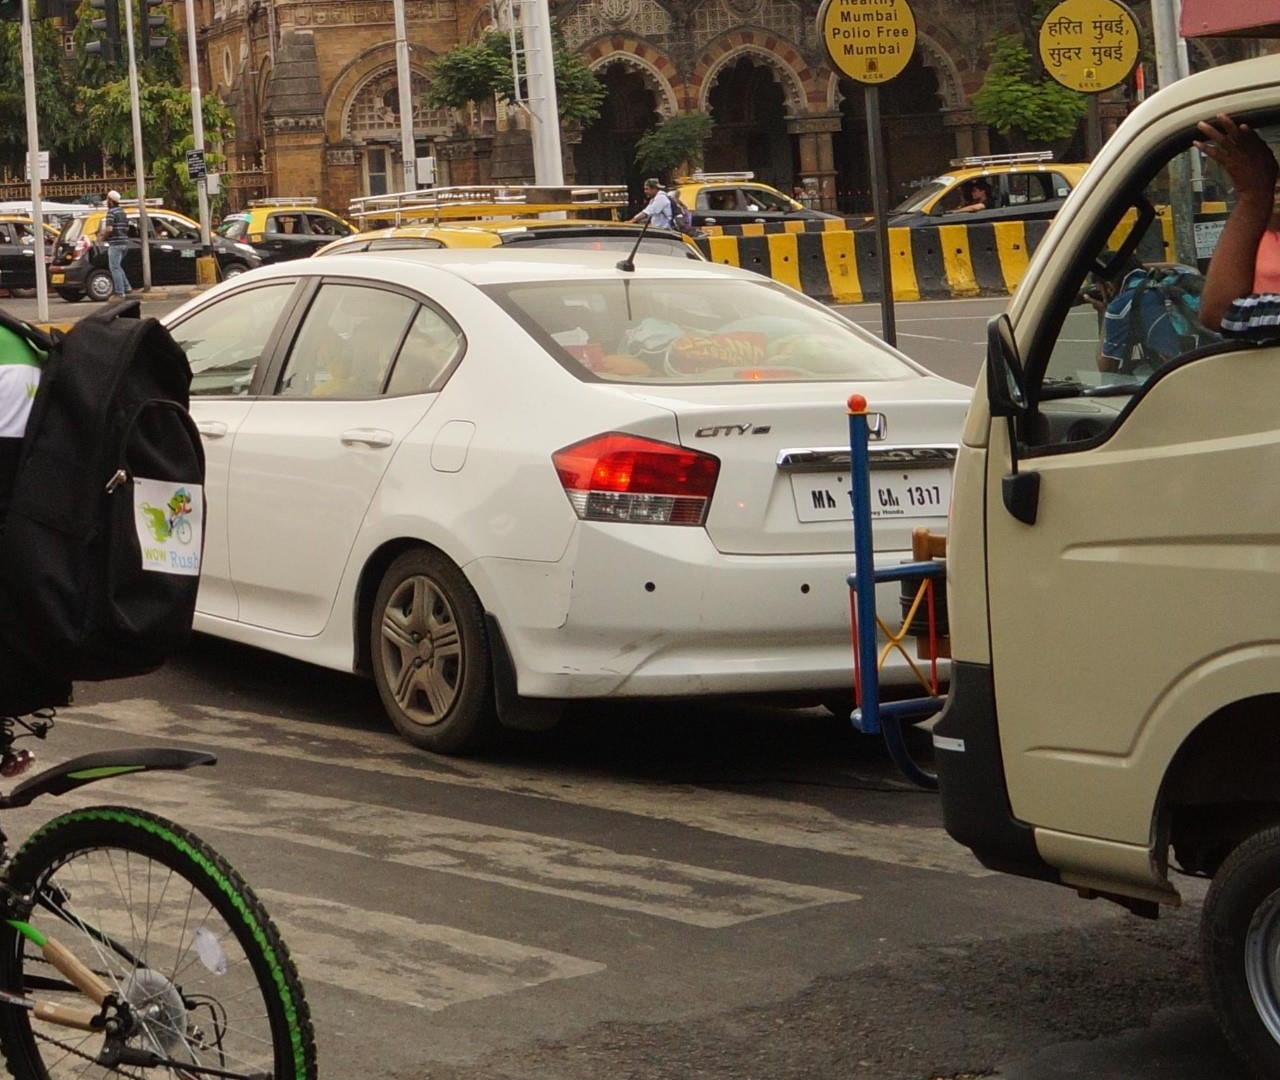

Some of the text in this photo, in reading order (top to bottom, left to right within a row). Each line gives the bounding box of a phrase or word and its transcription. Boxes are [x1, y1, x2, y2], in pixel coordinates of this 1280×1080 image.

[841, 9, 898, 22] Mumbai
[832, 26, 909, 39] Polio Free
[1047, 16, 1083, 37] हरित
[843, 42, 900, 55] Mumbai
[1047, 40, 1124, 67] सुंदर मुंबई
[694, 423, 752, 438] CITY
[169, 551, 199, 569] Rush
